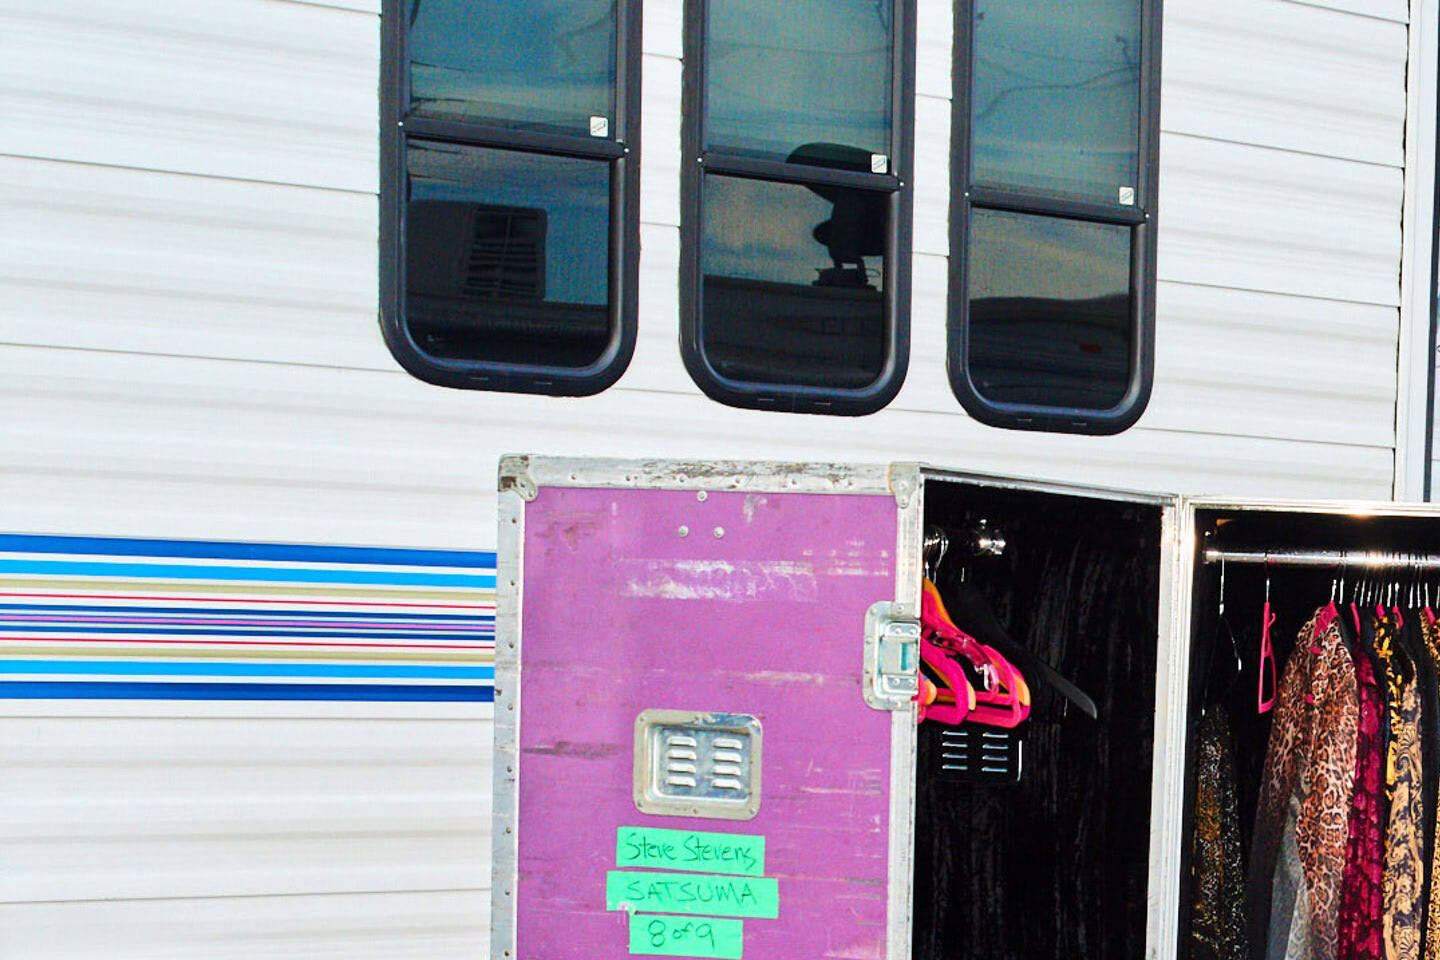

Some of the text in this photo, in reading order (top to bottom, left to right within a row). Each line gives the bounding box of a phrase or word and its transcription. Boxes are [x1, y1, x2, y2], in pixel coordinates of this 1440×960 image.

[625, 832, 757, 871] Steve Stevens
[625, 880, 758, 905] SATSUMA
[648, 919, 715, 949] 8 of 9
